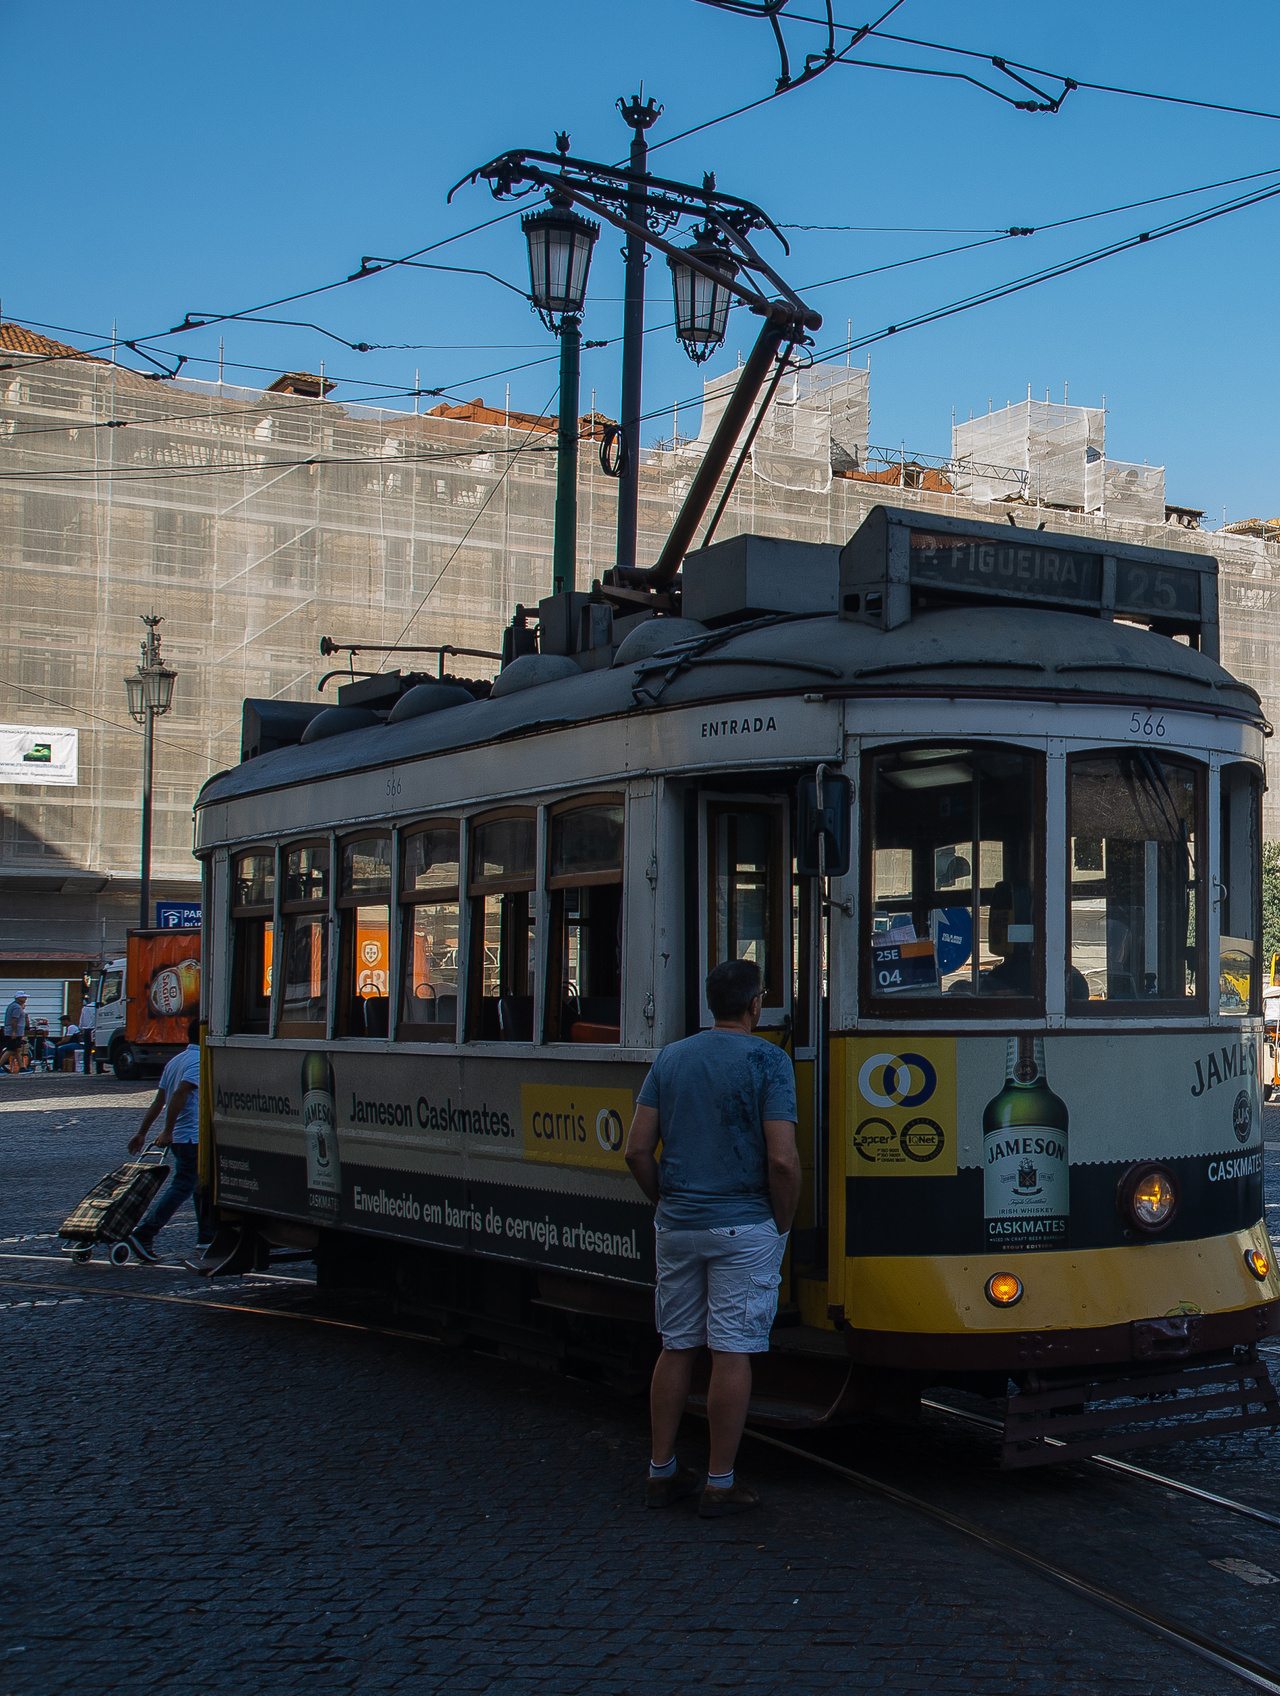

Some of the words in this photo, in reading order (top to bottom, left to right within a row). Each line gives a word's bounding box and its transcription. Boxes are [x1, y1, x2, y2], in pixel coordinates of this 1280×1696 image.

[951, 543, 1077, 583] FIGUEIRA
[1127, 567, 1177, 610] 25
[701, 716, 777, 738] ENTRADA
[1130, 713, 1165, 737] 566
[385, 776, 402, 797] 566
[876, 949, 900, 962] 25E
[357, 969, 389, 993] GR
[878, 969, 902, 986] 04
[162, 973, 174, 1014] SAGRES
[216, 1084, 300, 1116] Apresentamos...
[350, 1092, 413, 1128] Jameson
[416, 1096, 515, 1138] Caskmates.
[531, 1102, 587, 1143] carris
[860, 1135, 890, 1147] apcer
[908, 1135, 936, 1146] IQNet
[988, 1138, 1066, 1164] JAMESON
[1208, 1153, 1262, 1182] CASKMATES
[353, 1185, 421, 1221] Envelhecido
[422, 1204, 442, 1225] em
[444, 1199, 482, 1232] barris
[485, 1206, 503, 1235] de
[505, 1215, 559, 1251] cerveja
[562, 1222, 641, 1260] artesanal.
[989, 1220, 1066, 1235] CASKMATES
